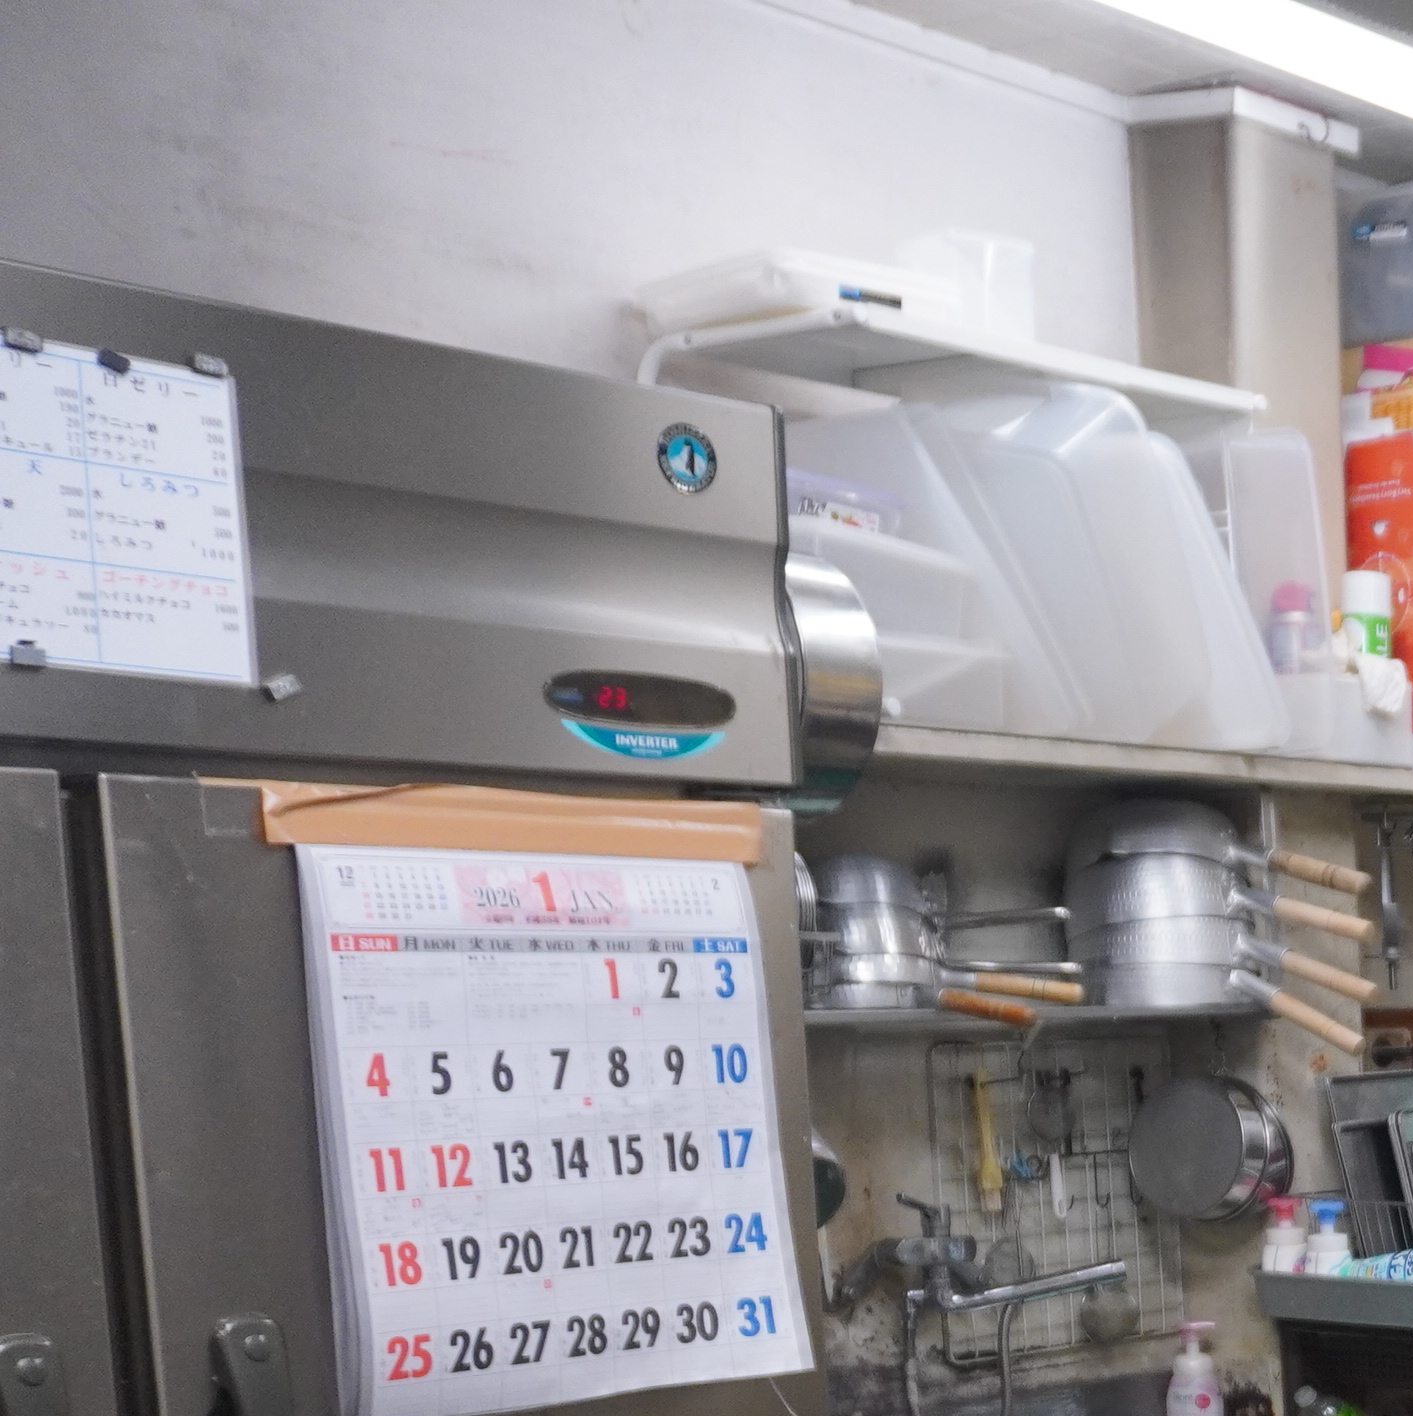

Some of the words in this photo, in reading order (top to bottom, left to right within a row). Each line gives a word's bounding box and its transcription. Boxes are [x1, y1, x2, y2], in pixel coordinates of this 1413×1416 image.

[615, 732, 678, 749] INVERTER
[335, 866, 355, 881] 12
[474, 886, 521, 908] 2026
[532, 870, 557, 913] 1
[711, 877, 720, 891] 2
[338, 935, 355, 951] 日
[358, 937, 392, 951] SUN
[403, 936, 419, 951] 月
[423, 937, 457, 951] MON
[469, 937, 484, 950] 火
[489, 938, 514, 951] TUE
[528, 938, 542, 951] 水
[546, 940, 575, 951] WED
[587, 939, 600, 951] 木
[604, 940, 631, 951] THU
[649, 939, 661, 951] 金
[664, 940, 685, 951] FRI
[702, 938, 714, 951] 土
[717, 939, 741, 951] SAT
[604, 958, 620, 999] 1
[657, 957, 681, 999] 2
[714, 957, 737, 999] 3
[366, 1053, 391, 1097] 4
[431, 1051, 452, 1095] 5
[492, 1050, 514, 1092] 6
[550, 1048, 570, 1090] 7
[608, 1045, 630, 1088] 8
[663, 1044, 685, 1086] 9
[711, 1043, 749, 1084] 10
[369, 1147, 405, 1193] 11
[430, 1143, 474, 1188] 12
[493, 1139, 533, 1184] 13
[551, 1137, 589, 1180] 14
[608, 1134, 645, 1176] 15
[663, 1130, 700, 1172] 16
[718, 1127, 754, 1169] 17
[379, 1241, 423, 1287] 18
[441, 1236, 481, 1280] 19
[500, 1229, 544, 1275] 20
[559, 1225, 596, 1270] 21
[612, 1220, 655, 1264] 22
[667, 1216, 712, 1260] 23
[724, 1212, 769, 1254] 24
[387, 1334, 433, 1381] 25
[449, 1327, 495, 1374] 26
[509, 1320, 551, 1366] 27
[566, 1313, 609, 1359] 28
[621, 1307, 661, 1351] 29
[675, 1301, 719, 1345] 30
[736, 1295, 778, 1338] 31
